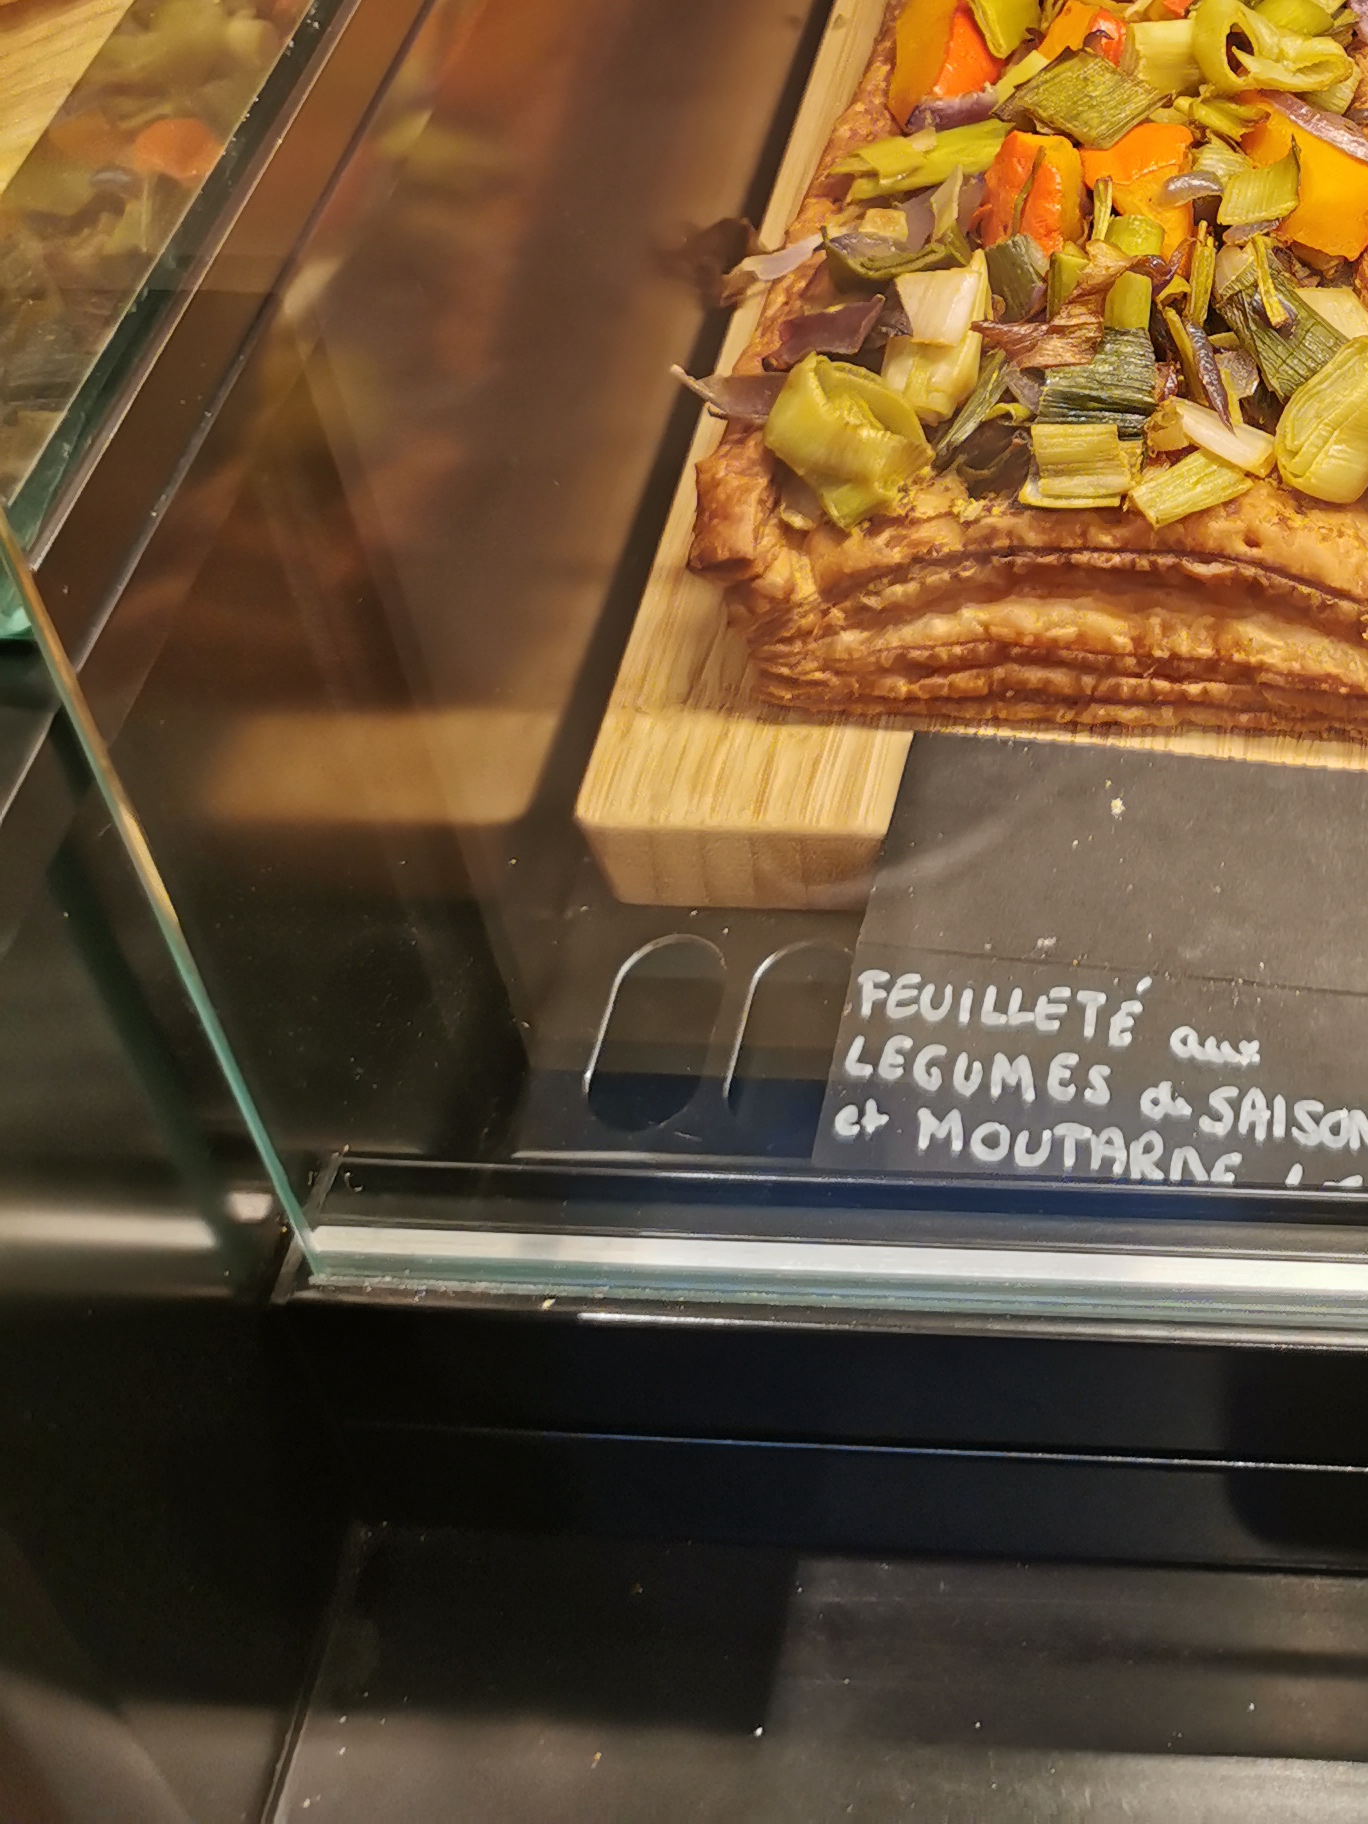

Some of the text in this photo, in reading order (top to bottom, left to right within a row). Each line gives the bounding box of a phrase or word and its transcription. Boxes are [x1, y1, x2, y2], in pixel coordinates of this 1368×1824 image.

[858, 969, 1260, 1065] FEUILLETÉ aux
[844, 1034, 1111, 1105] LEGUMES
[834, 1098, 889, 1136] et
